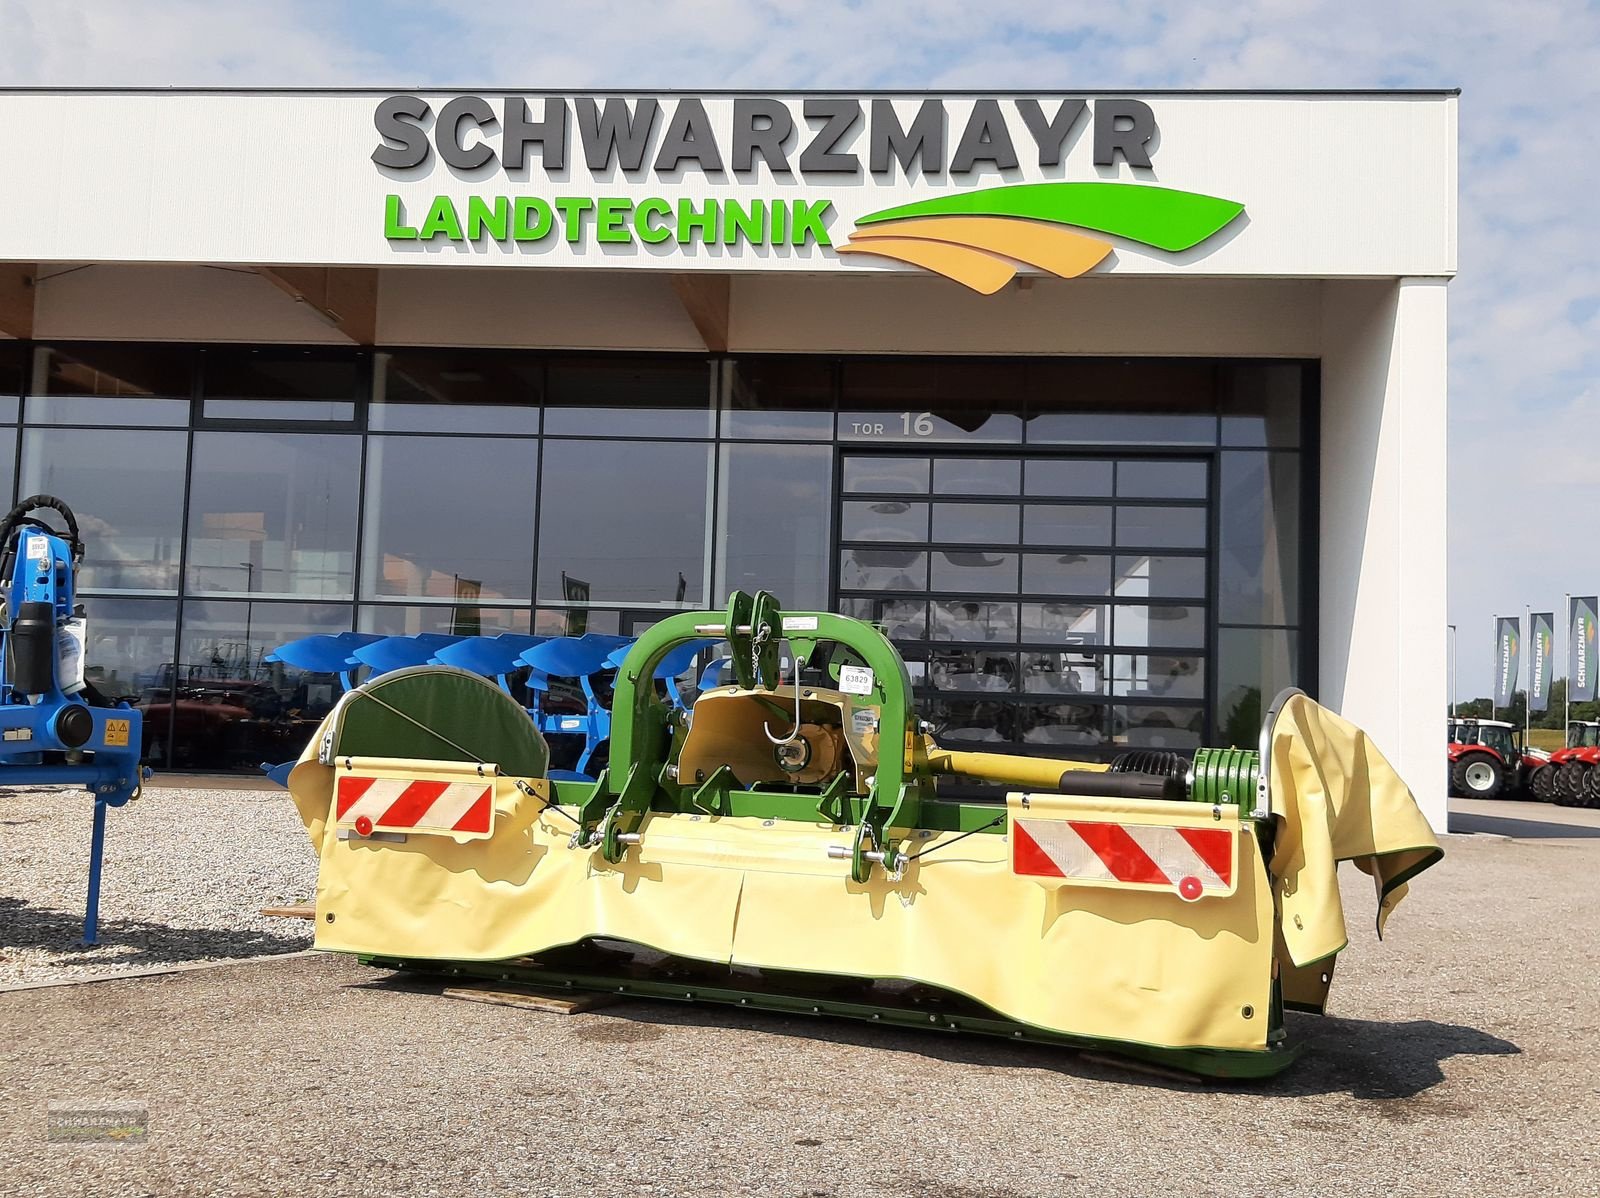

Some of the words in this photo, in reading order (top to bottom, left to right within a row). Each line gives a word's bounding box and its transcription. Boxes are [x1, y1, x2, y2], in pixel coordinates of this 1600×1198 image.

[371, 96, 1154, 175] SCHWARZMAYR
[384, 194, 833, 247] LANDTECHNIK
[852, 423, 884, 435] TOR
[900, 411, 934, 436] 16
[845, 674, 868, 684] 63829
